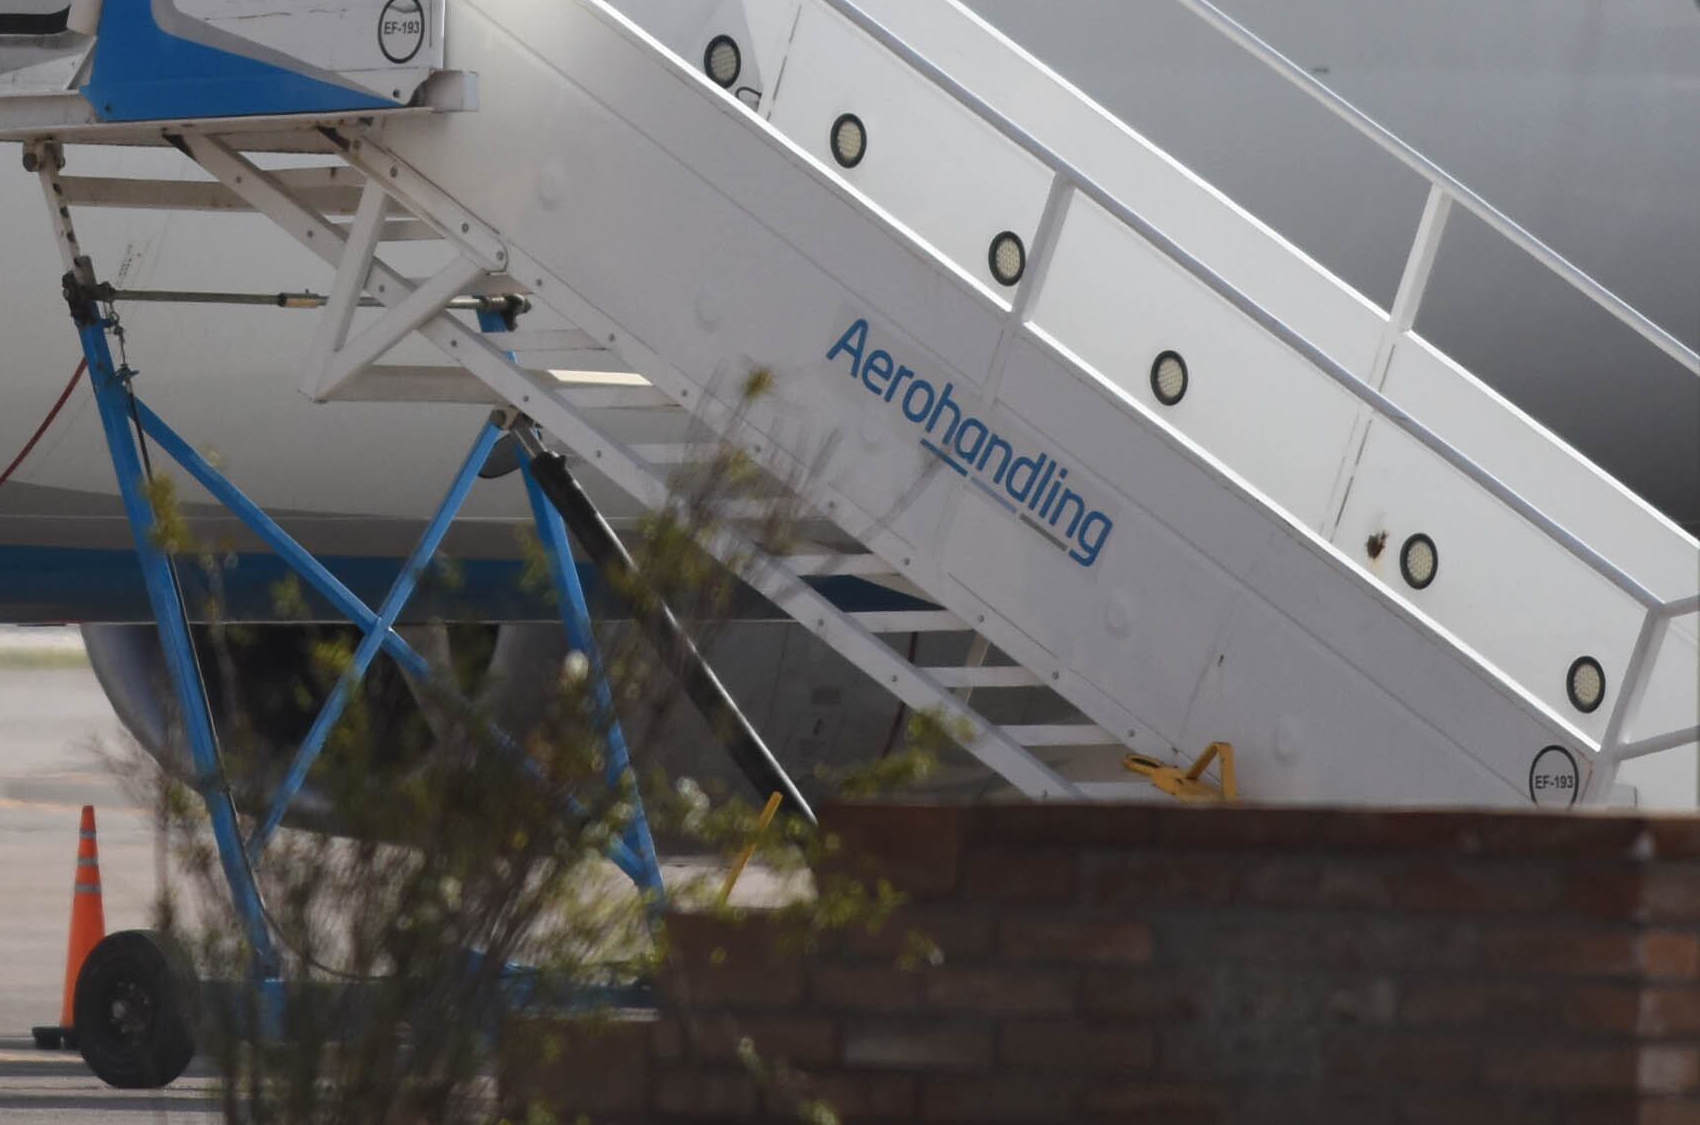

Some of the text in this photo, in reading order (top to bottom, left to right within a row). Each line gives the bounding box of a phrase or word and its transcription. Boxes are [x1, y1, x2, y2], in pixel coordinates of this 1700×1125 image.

[383, 21, 420, 35] EF-193
[825, 318, 1113, 568] Aerohandling
[1534, 774, 1574, 789] EF-193
